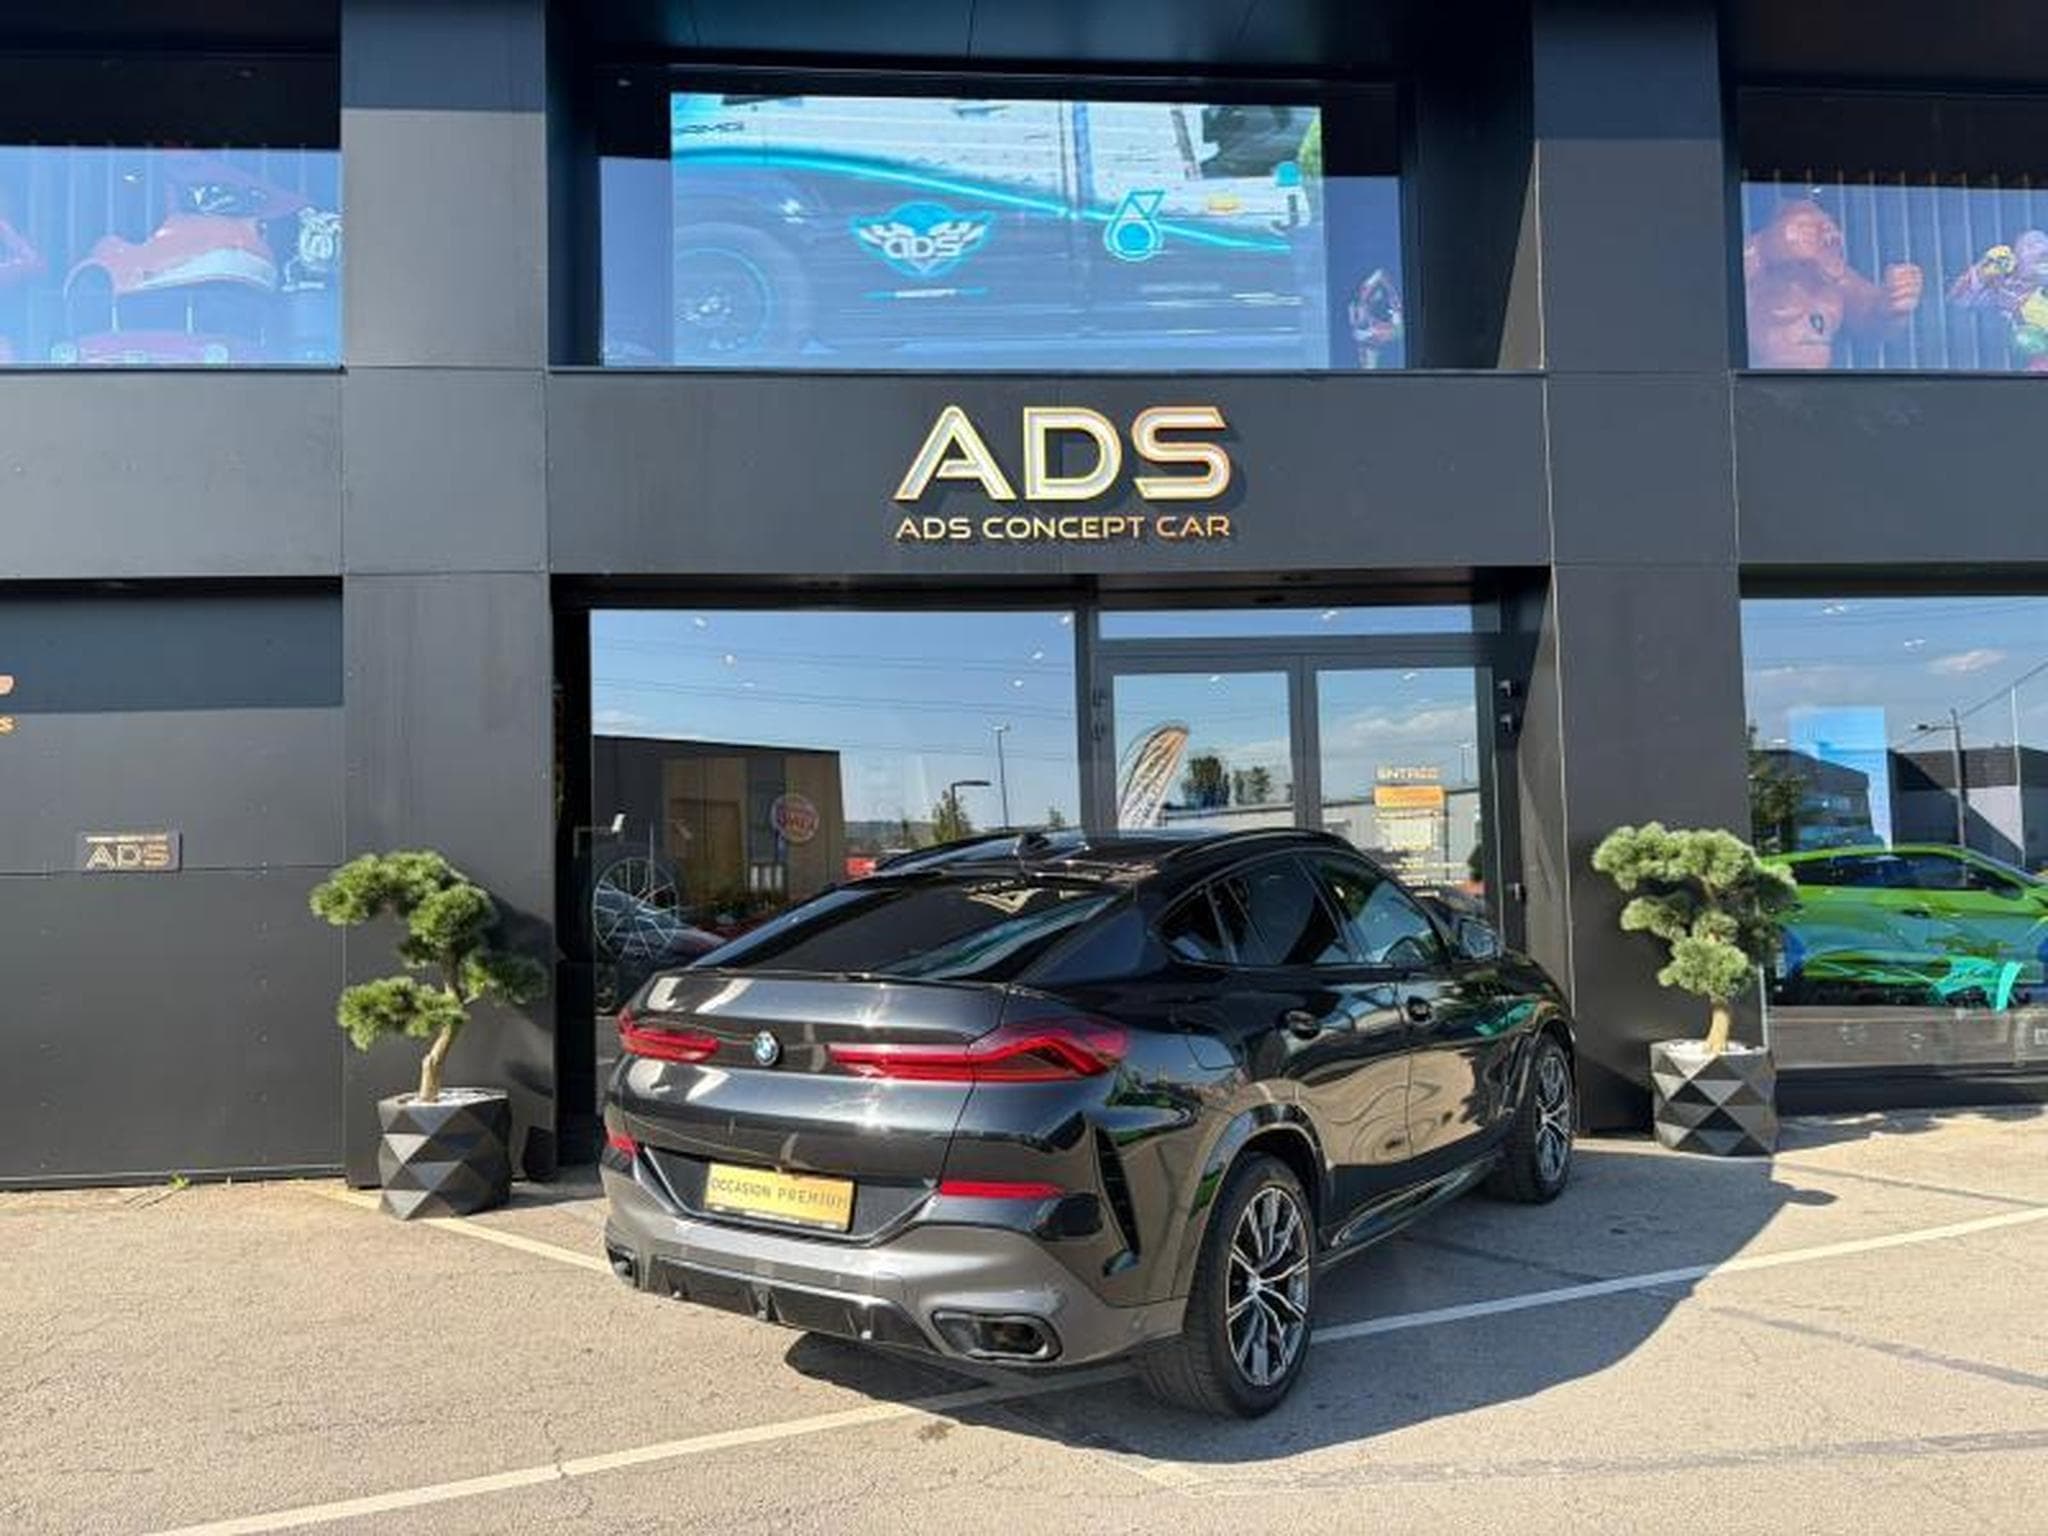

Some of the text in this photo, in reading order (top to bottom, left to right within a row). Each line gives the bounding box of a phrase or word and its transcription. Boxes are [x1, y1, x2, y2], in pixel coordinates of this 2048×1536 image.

[893, 405, 1231, 500] ADS
[896, 516, 1231, 539] ADS CONCEPT CAR
[86, 844, 170, 868] ADS
[711, 1177, 849, 1209] OCCASION PREMIUM
